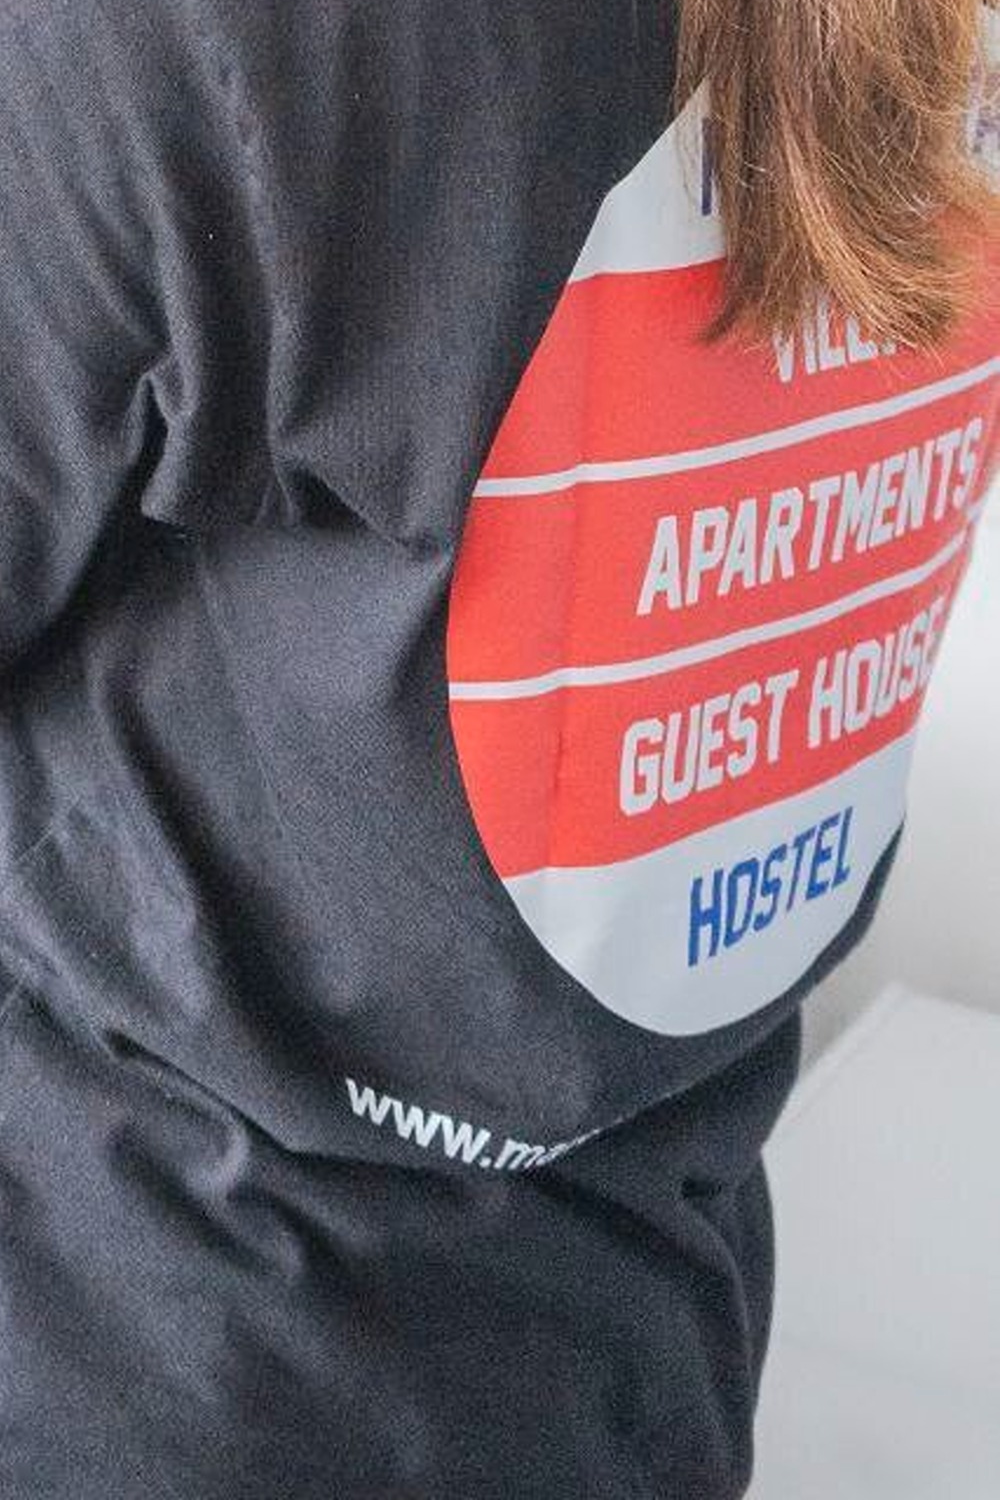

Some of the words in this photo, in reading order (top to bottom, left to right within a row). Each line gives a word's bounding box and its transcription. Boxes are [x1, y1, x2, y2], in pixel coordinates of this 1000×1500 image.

[637, 419, 982, 615] APARTMENTS
[620, 670, 799, 816] GUEST
[808, 596, 944, 749] HOUSE
[687, 806, 854, 966] HOSTEL
[345, 1077, 568, 1169] www.m
